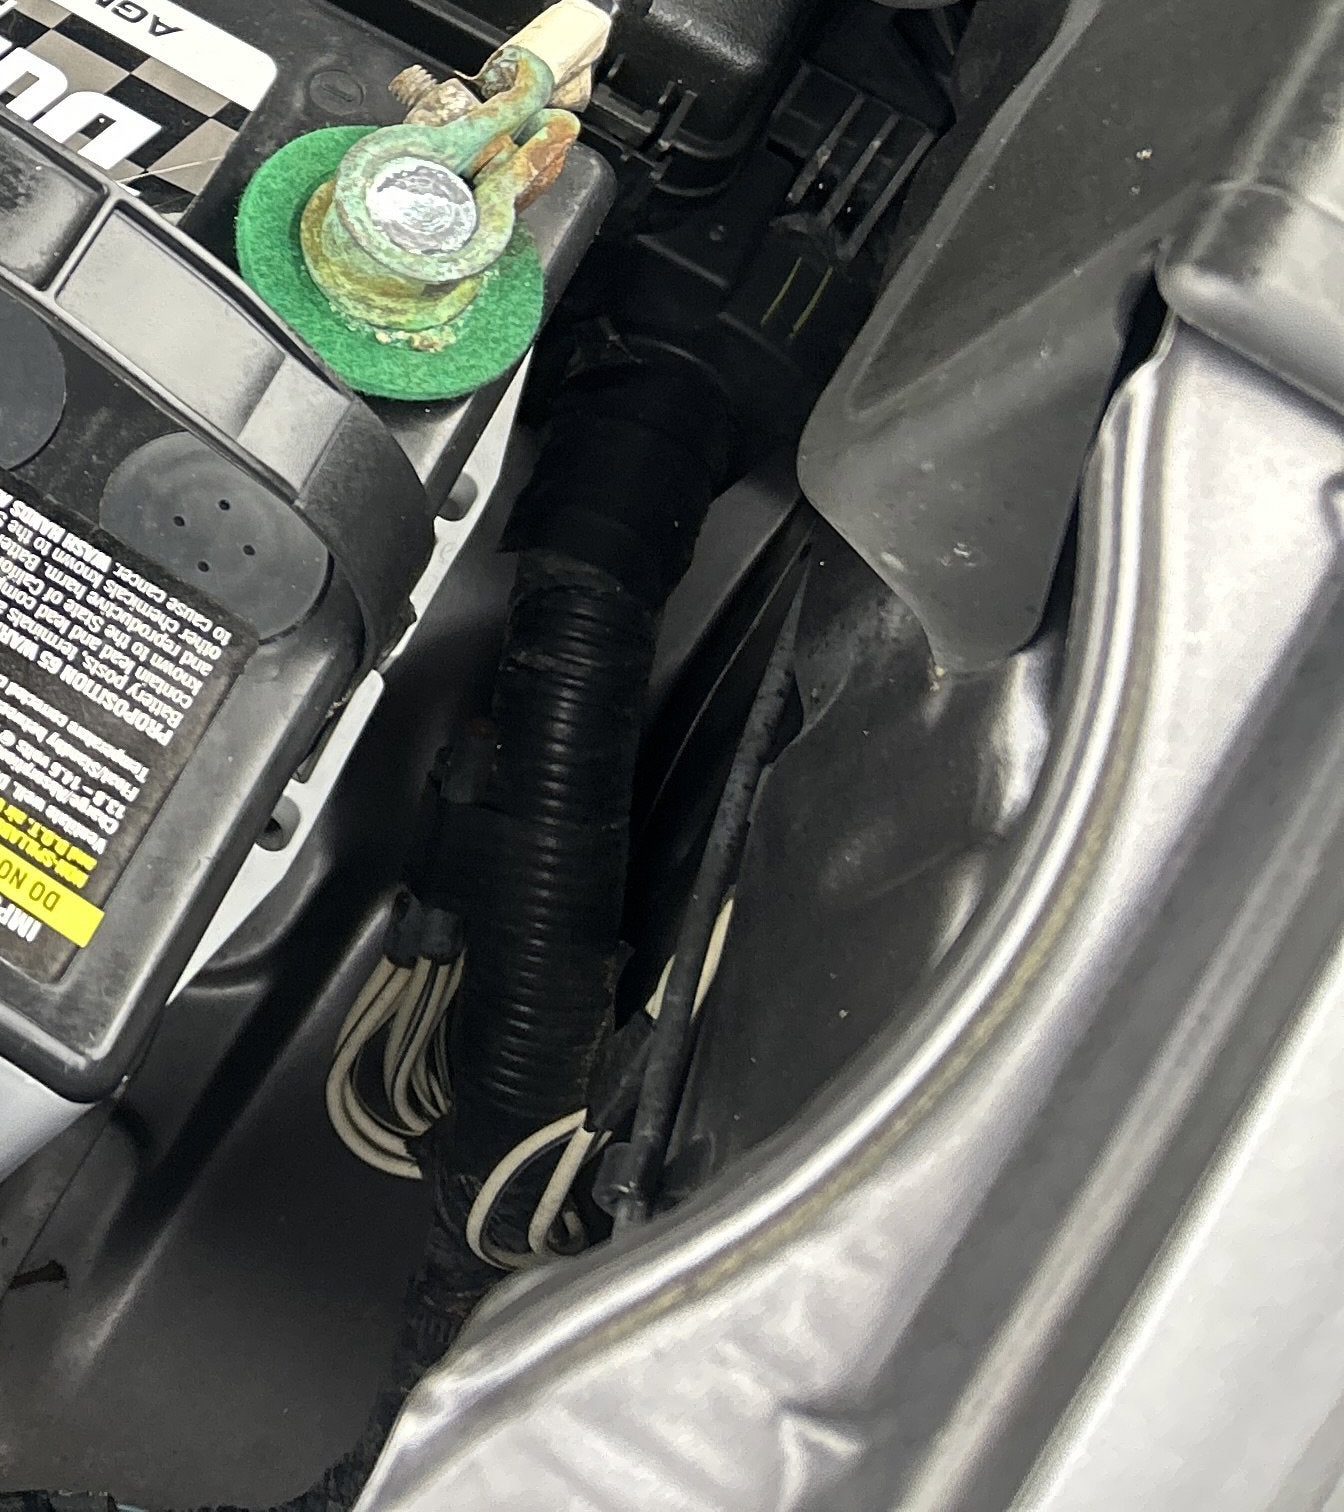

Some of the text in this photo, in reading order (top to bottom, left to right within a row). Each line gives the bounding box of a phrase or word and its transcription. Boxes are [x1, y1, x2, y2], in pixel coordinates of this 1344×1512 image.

[36, 559, 89, 601] harm.
[40, 583, 66, 608] of
[32, 600, 73, 634] lead
[59, 595, 107, 633] State
[81, 584, 186, 660] reproductive
[162, 593, 216, 635] cause
[2, 604, 81, 662] terminals
[65, 621, 104, 655] and
[100, 620, 133, 650] the
[127, 638, 152, 662] to
[209, 623, 235, 647] to
[33, 647, 65, 677] 65
[74, 646, 131, 693] posts,
[96, 641, 138, 676] lead
[145, 649, 206, 697] known
[177, 647, 215, 680] and
[56, 662, 176, 748] PROPOSITION
[122, 677, 188, 730] Battery
[130, 663, 196, 714] contain
[27, 878, 64, 913] DO
